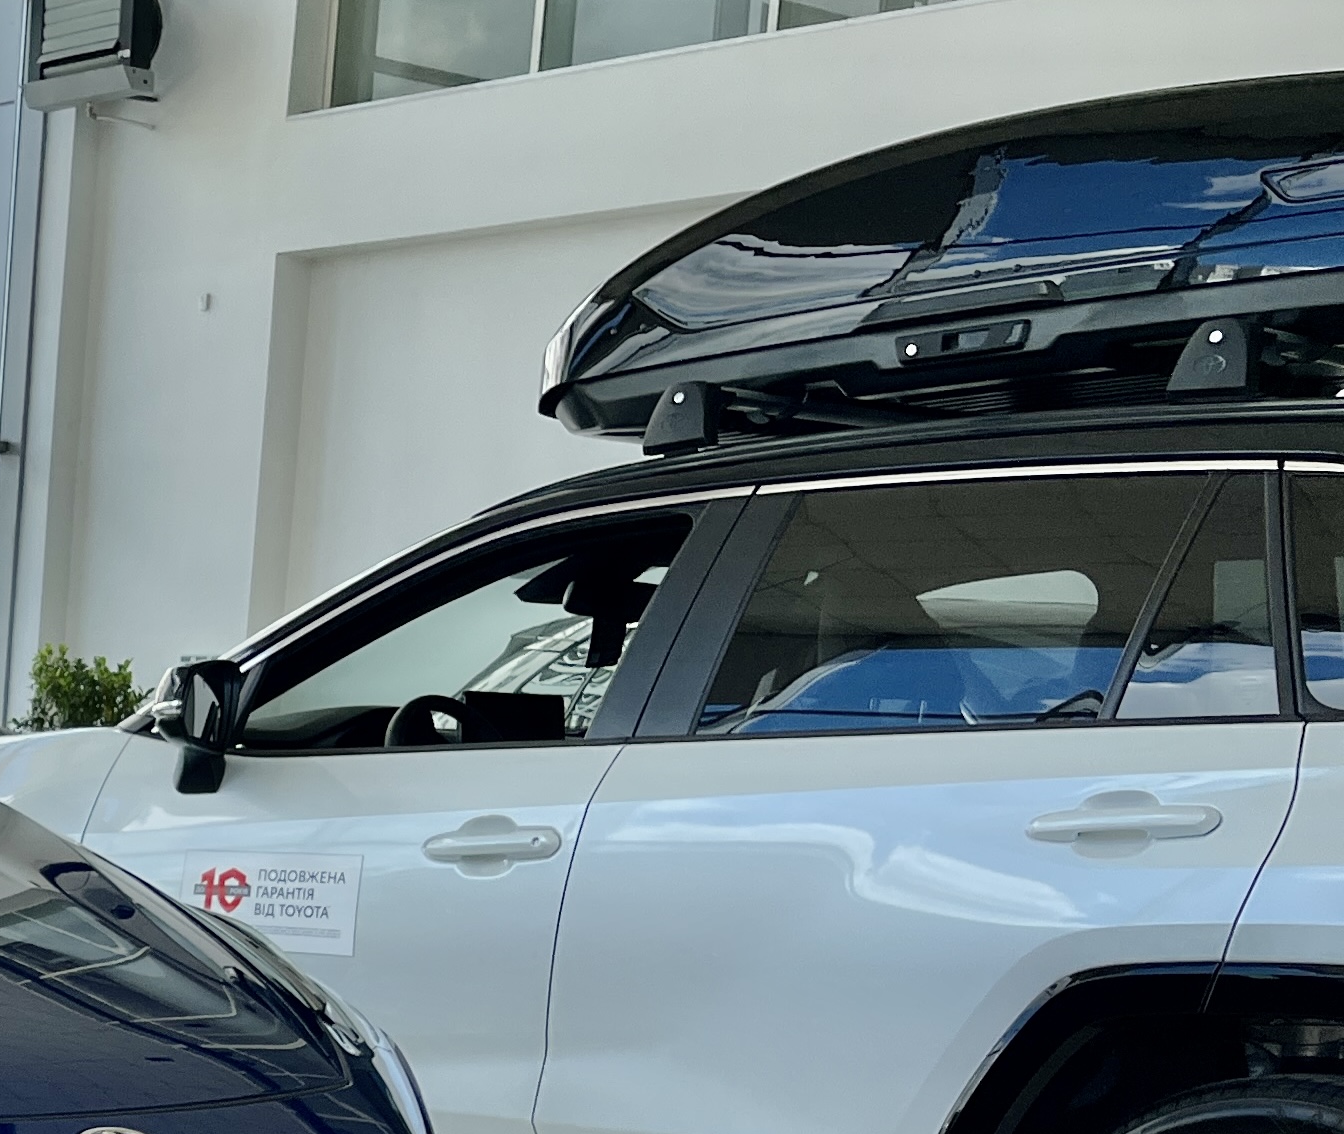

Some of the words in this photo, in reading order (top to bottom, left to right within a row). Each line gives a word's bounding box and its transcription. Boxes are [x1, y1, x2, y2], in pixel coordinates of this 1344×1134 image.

[257, 868, 346, 884] ПОДОВЖЕНА
[201, 867, 247, 913] 10
[255, 885, 315, 901] ГАРАНТІЯ
[254, 903, 275, 918] ВІД
[279, 904, 330, 919] TOYOTA
